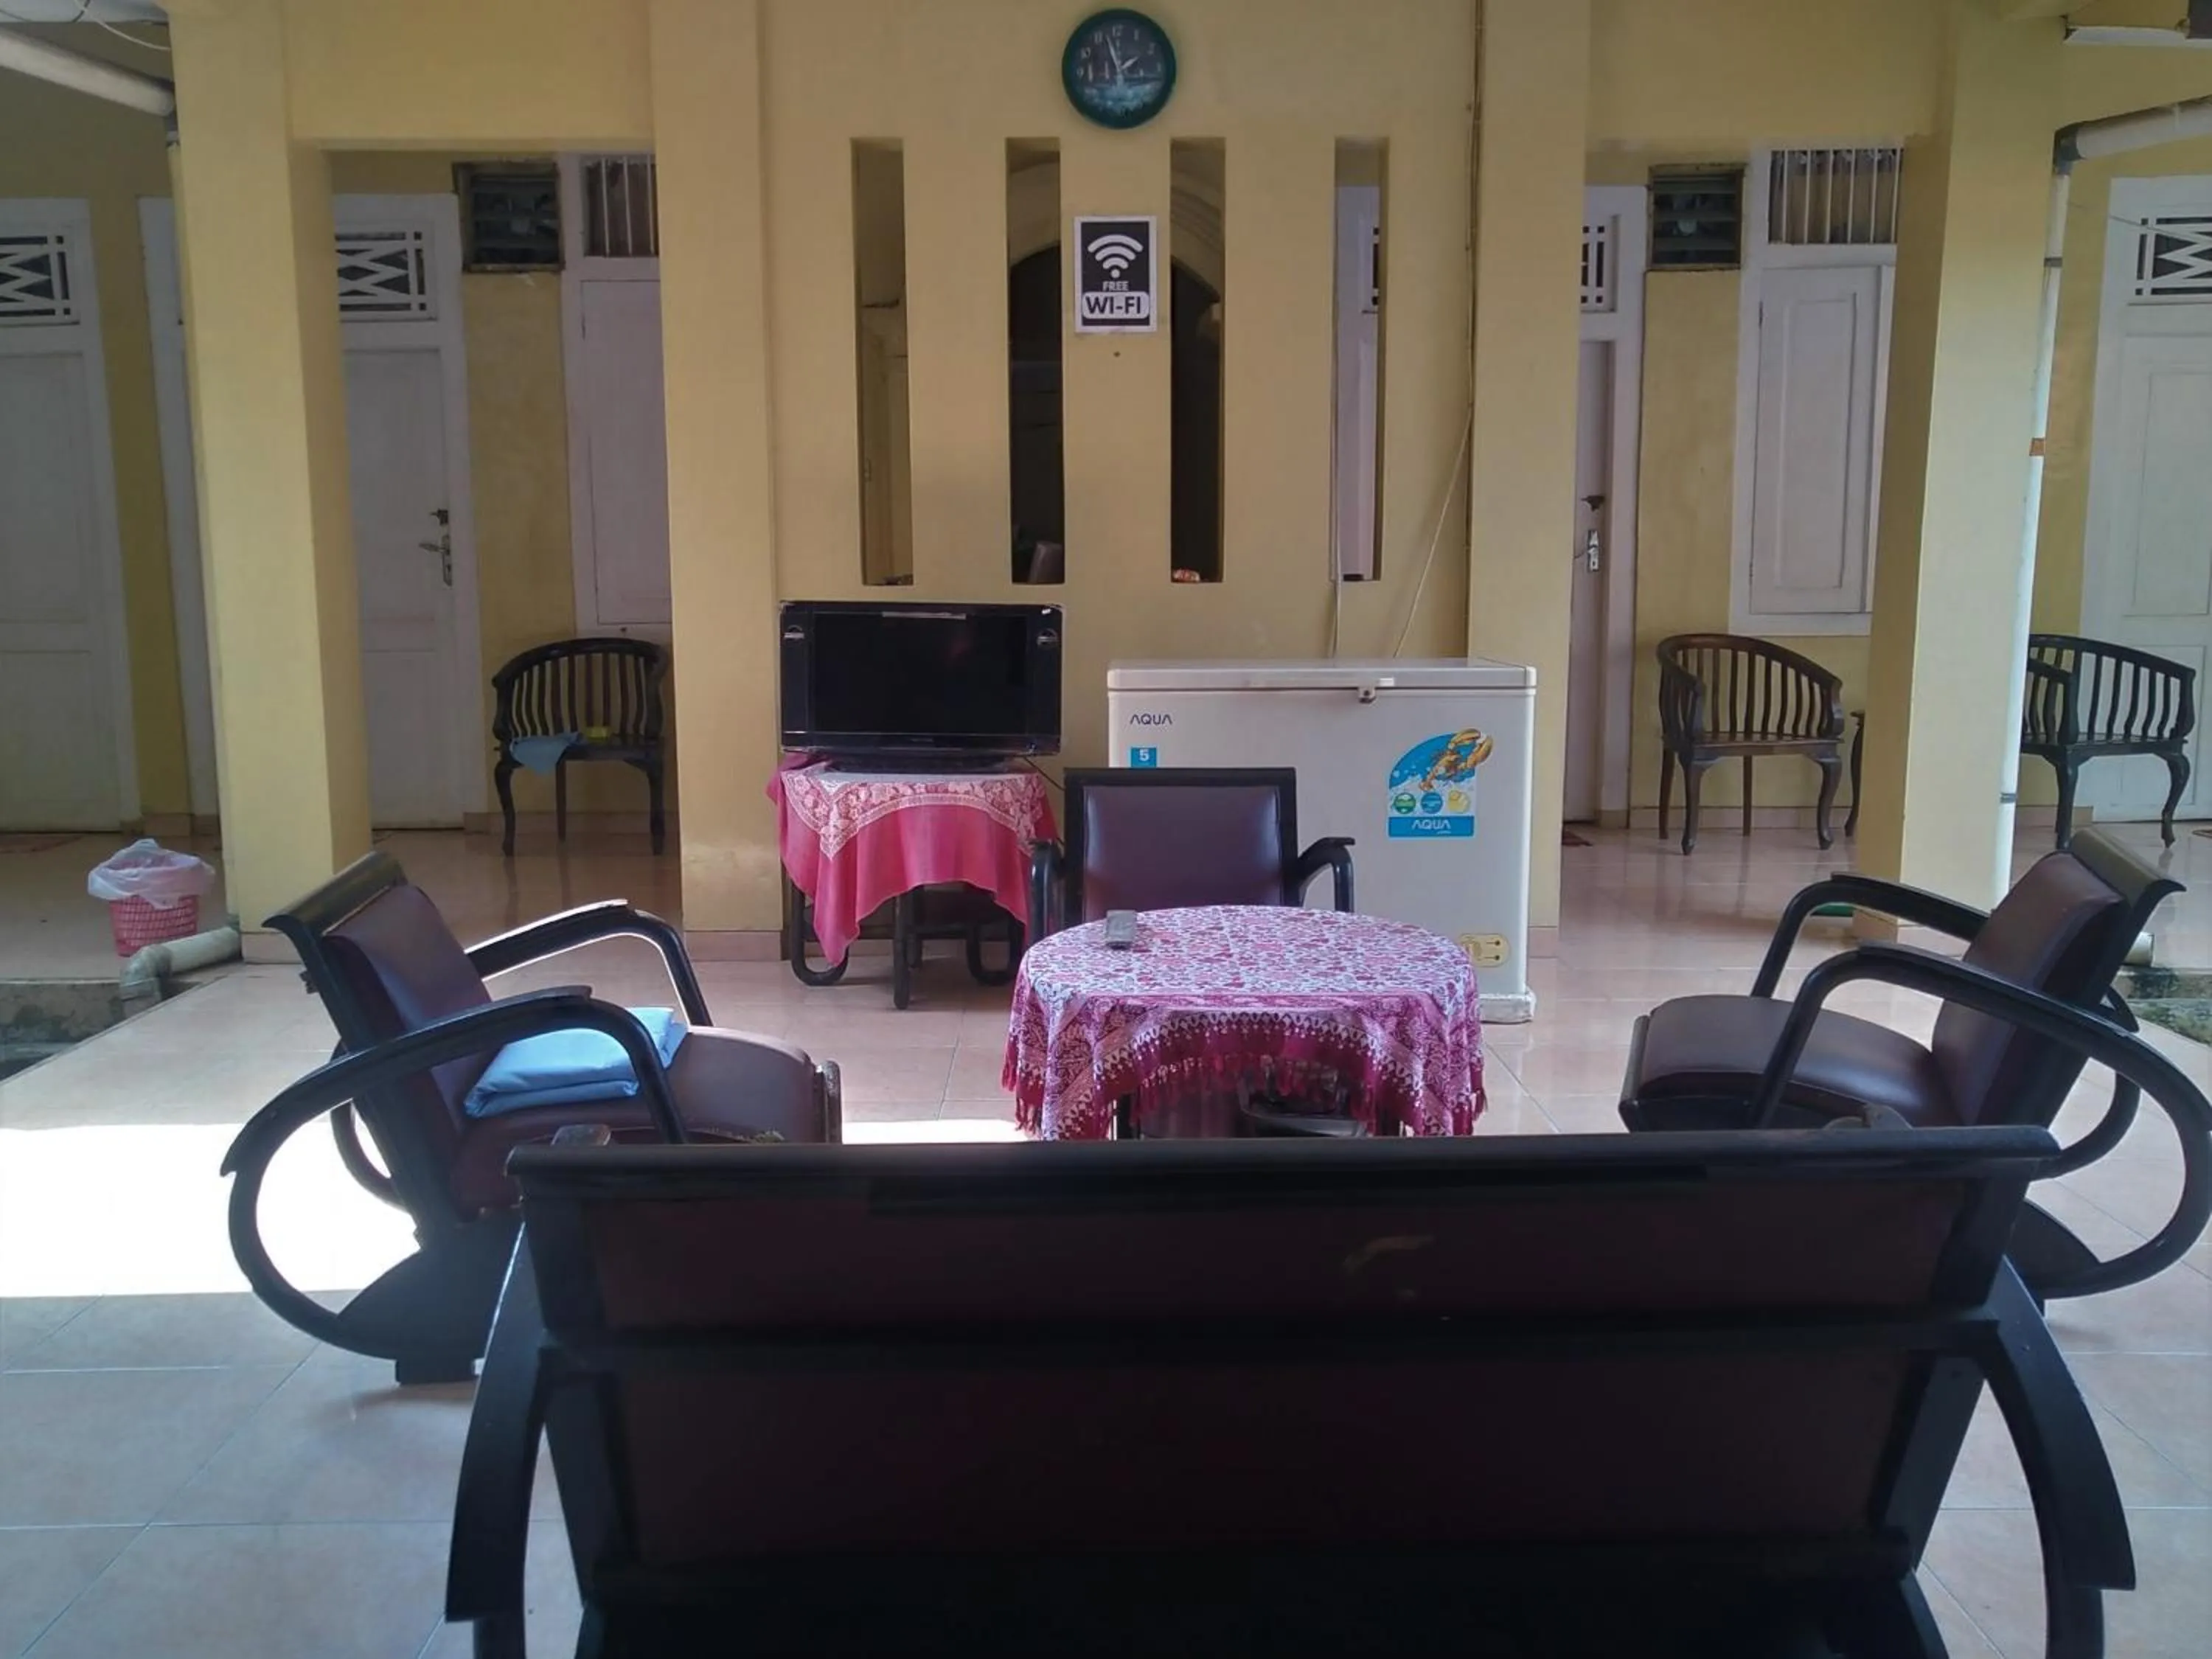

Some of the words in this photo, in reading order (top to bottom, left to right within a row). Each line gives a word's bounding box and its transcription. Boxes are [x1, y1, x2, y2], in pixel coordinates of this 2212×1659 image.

[1102, 281, 1129, 291] FREE
[1085, 296, 1141, 314] WI-FI
[1130, 713, 1172, 726] AQUA
[1139, 748, 1150, 761] 5
[1411, 819, 1451, 830] AQUA
